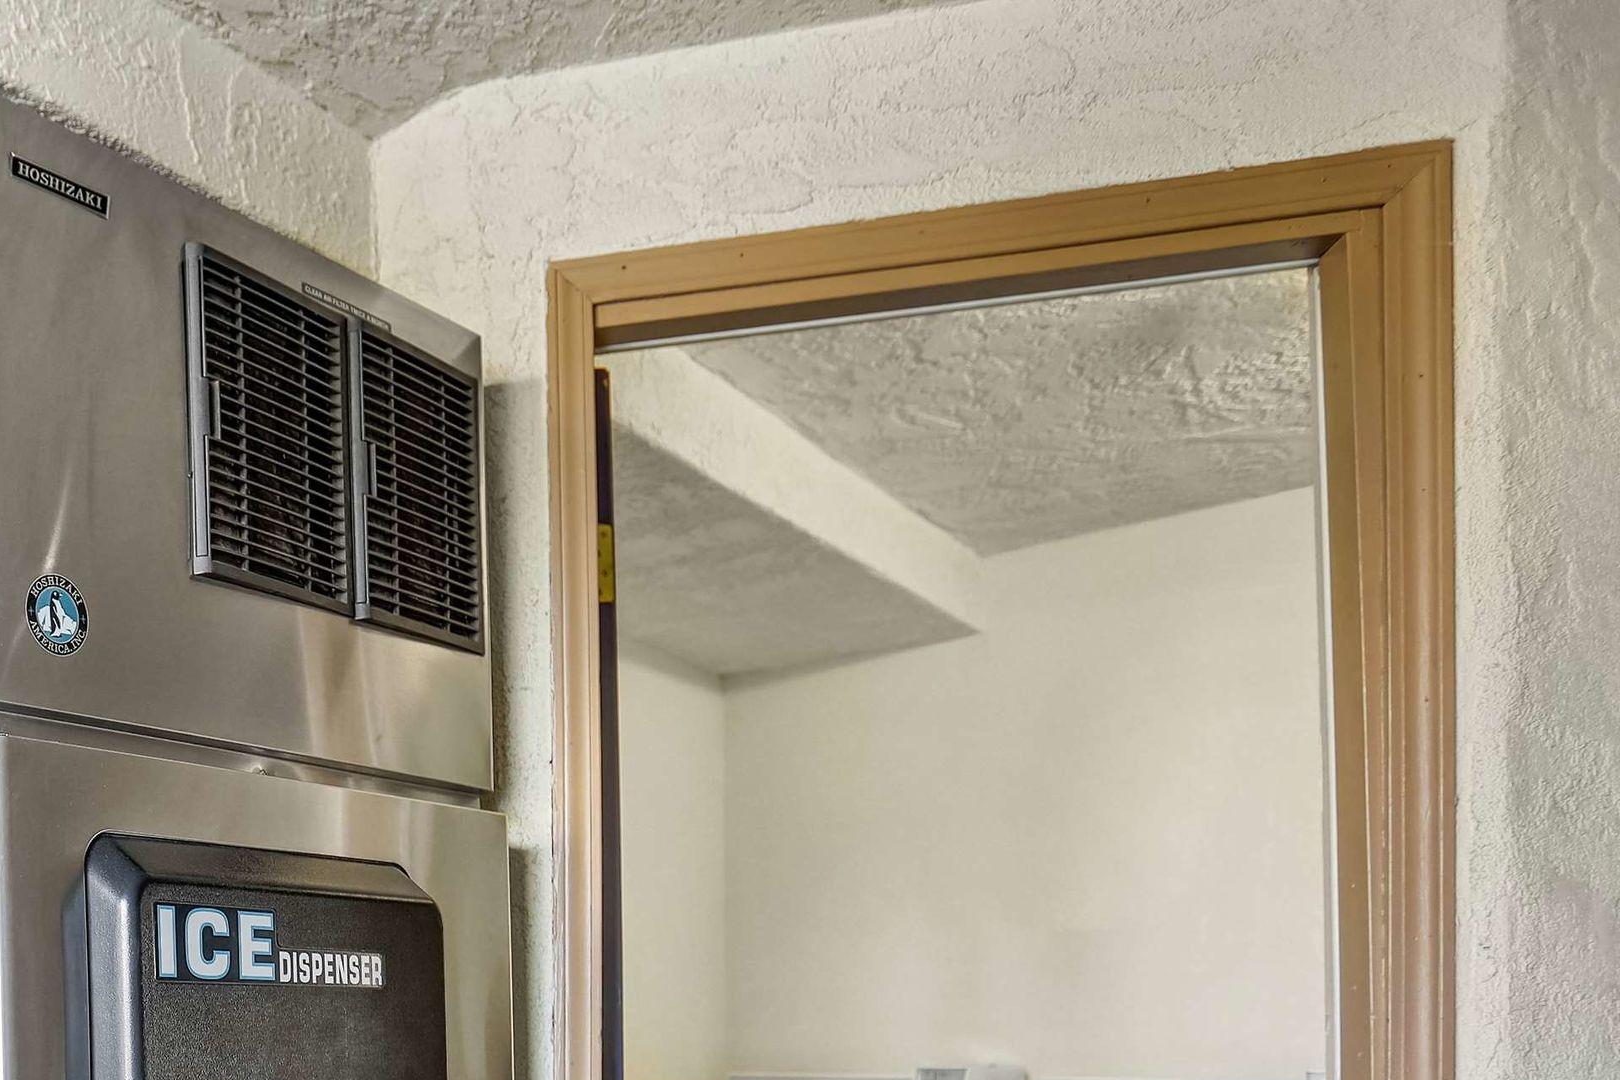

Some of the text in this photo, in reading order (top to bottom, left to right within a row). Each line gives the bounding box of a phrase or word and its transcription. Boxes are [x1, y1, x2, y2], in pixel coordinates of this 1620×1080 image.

[17, 160, 103, 210] HOSHIZAKI
[30, 576, 83, 605] HOSHIZAKI
[156, 904, 383, 986] ICE DISPENSER
